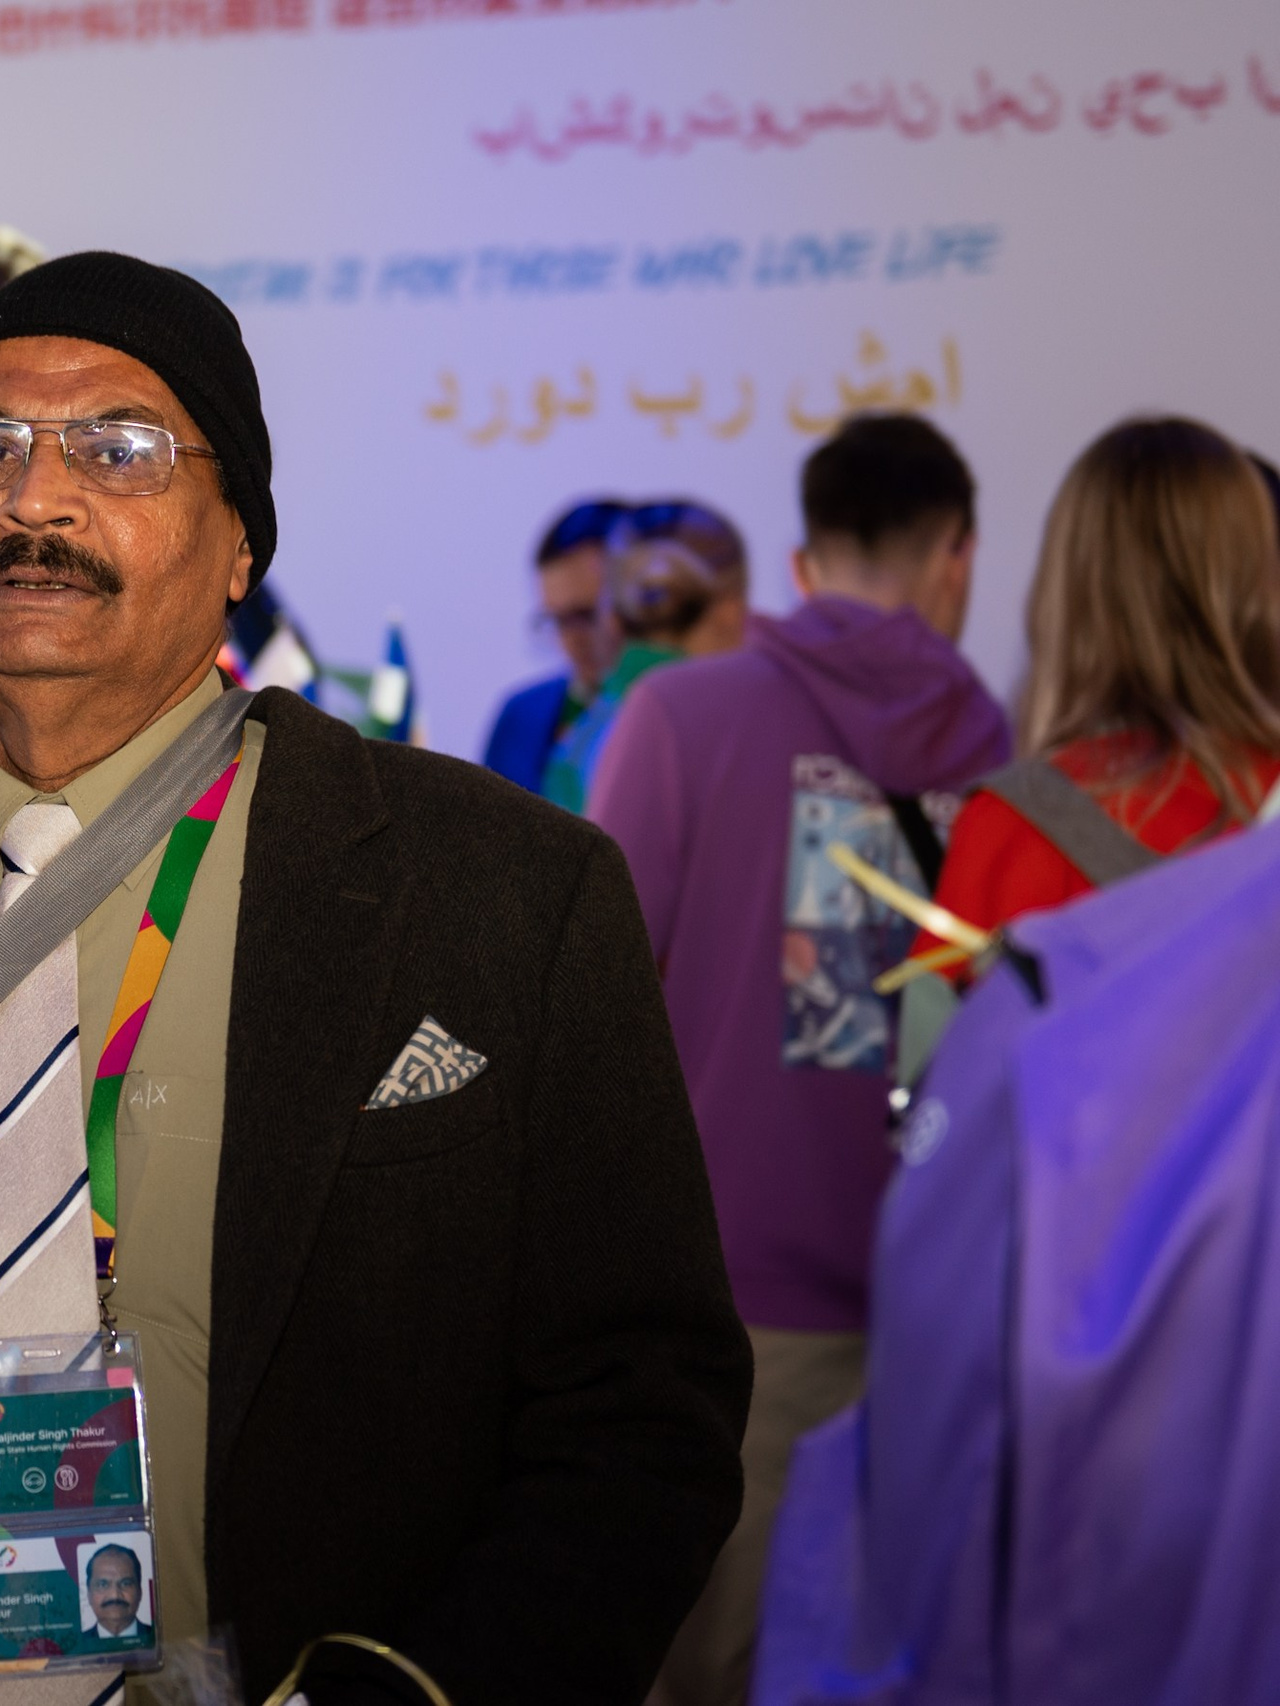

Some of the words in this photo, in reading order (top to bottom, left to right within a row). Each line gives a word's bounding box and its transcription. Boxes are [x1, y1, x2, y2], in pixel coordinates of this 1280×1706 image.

[755, 229, 875, 286] LOVE
[884, 223, 1002, 282] LIFE
[38, 1429, 68, 1441] Singh
[71, 1426, 106, 1438] Thakur
[27, 1444, 53, 1453] Human
[53, 1442, 75, 1453] Rights
[24, 1592, 54, 1606] Singh
